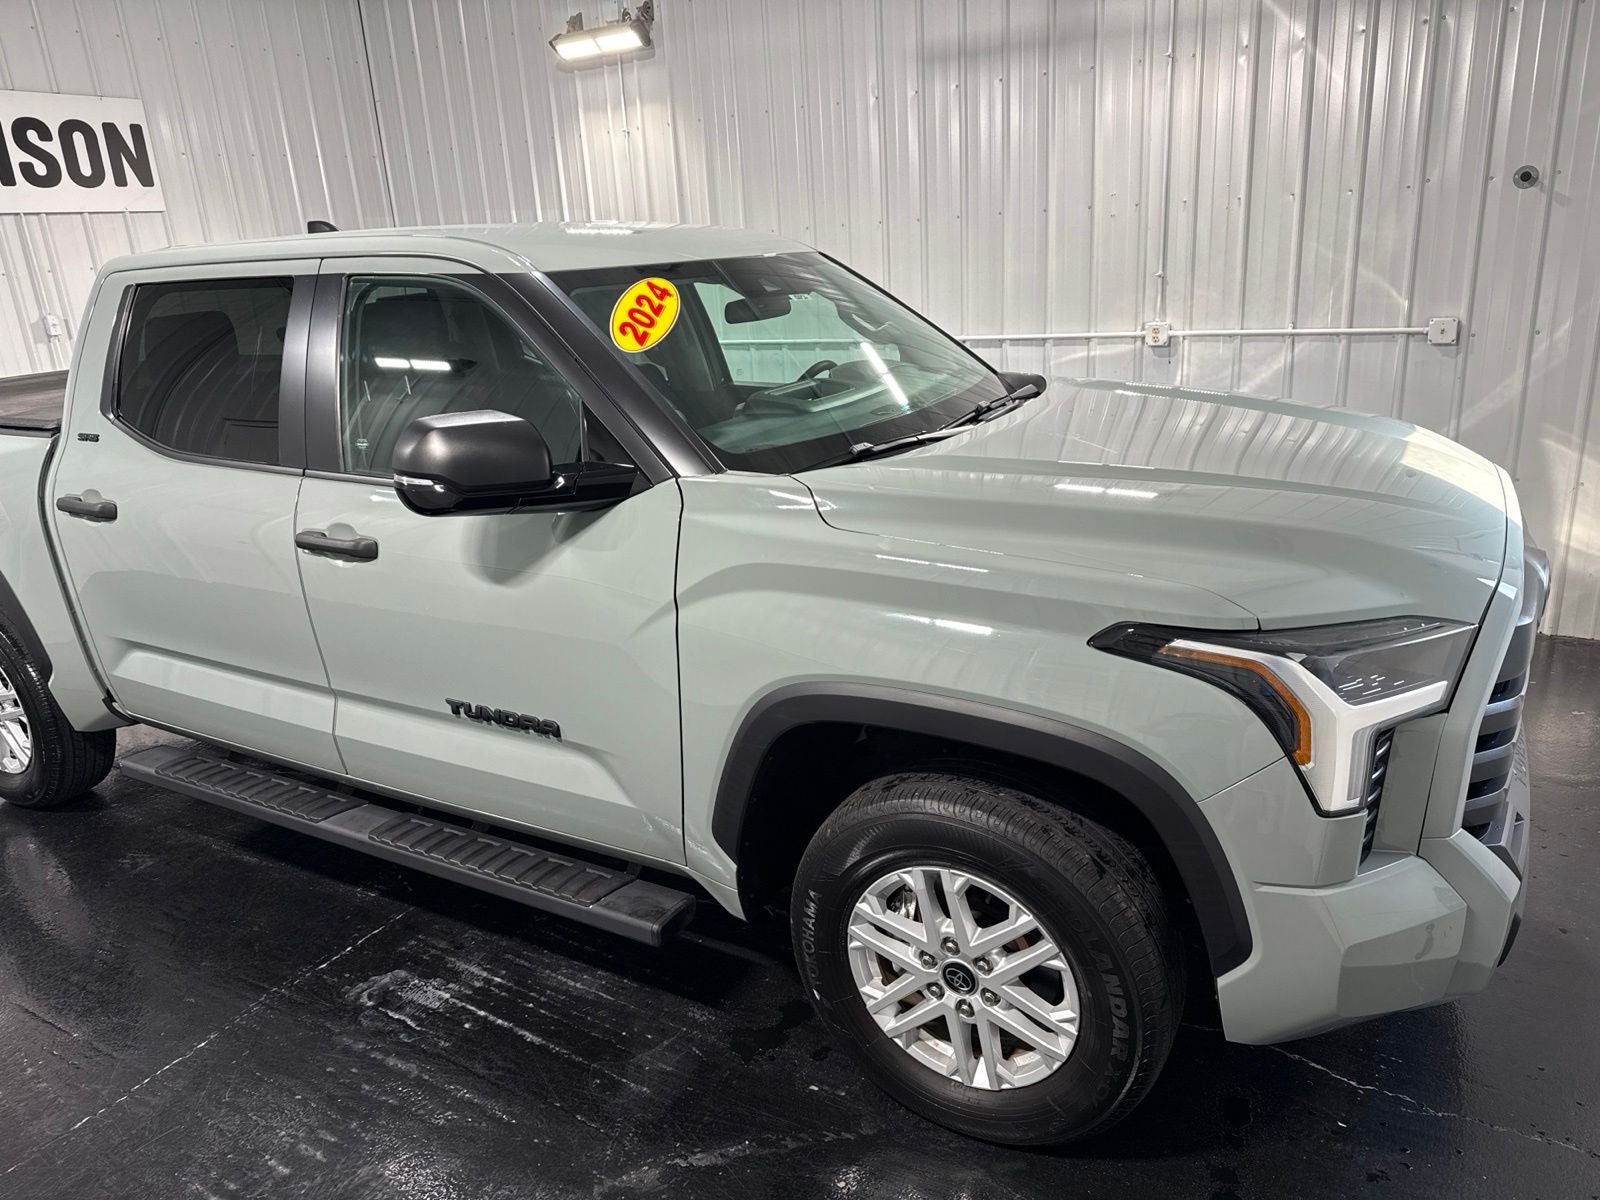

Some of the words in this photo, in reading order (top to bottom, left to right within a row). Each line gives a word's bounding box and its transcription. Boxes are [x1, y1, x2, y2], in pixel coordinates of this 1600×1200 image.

[619, 281, 673, 346] 2024
[445, 698, 562, 739] TUNDRA
[802, 889, 823, 984] YOKOHAMA
